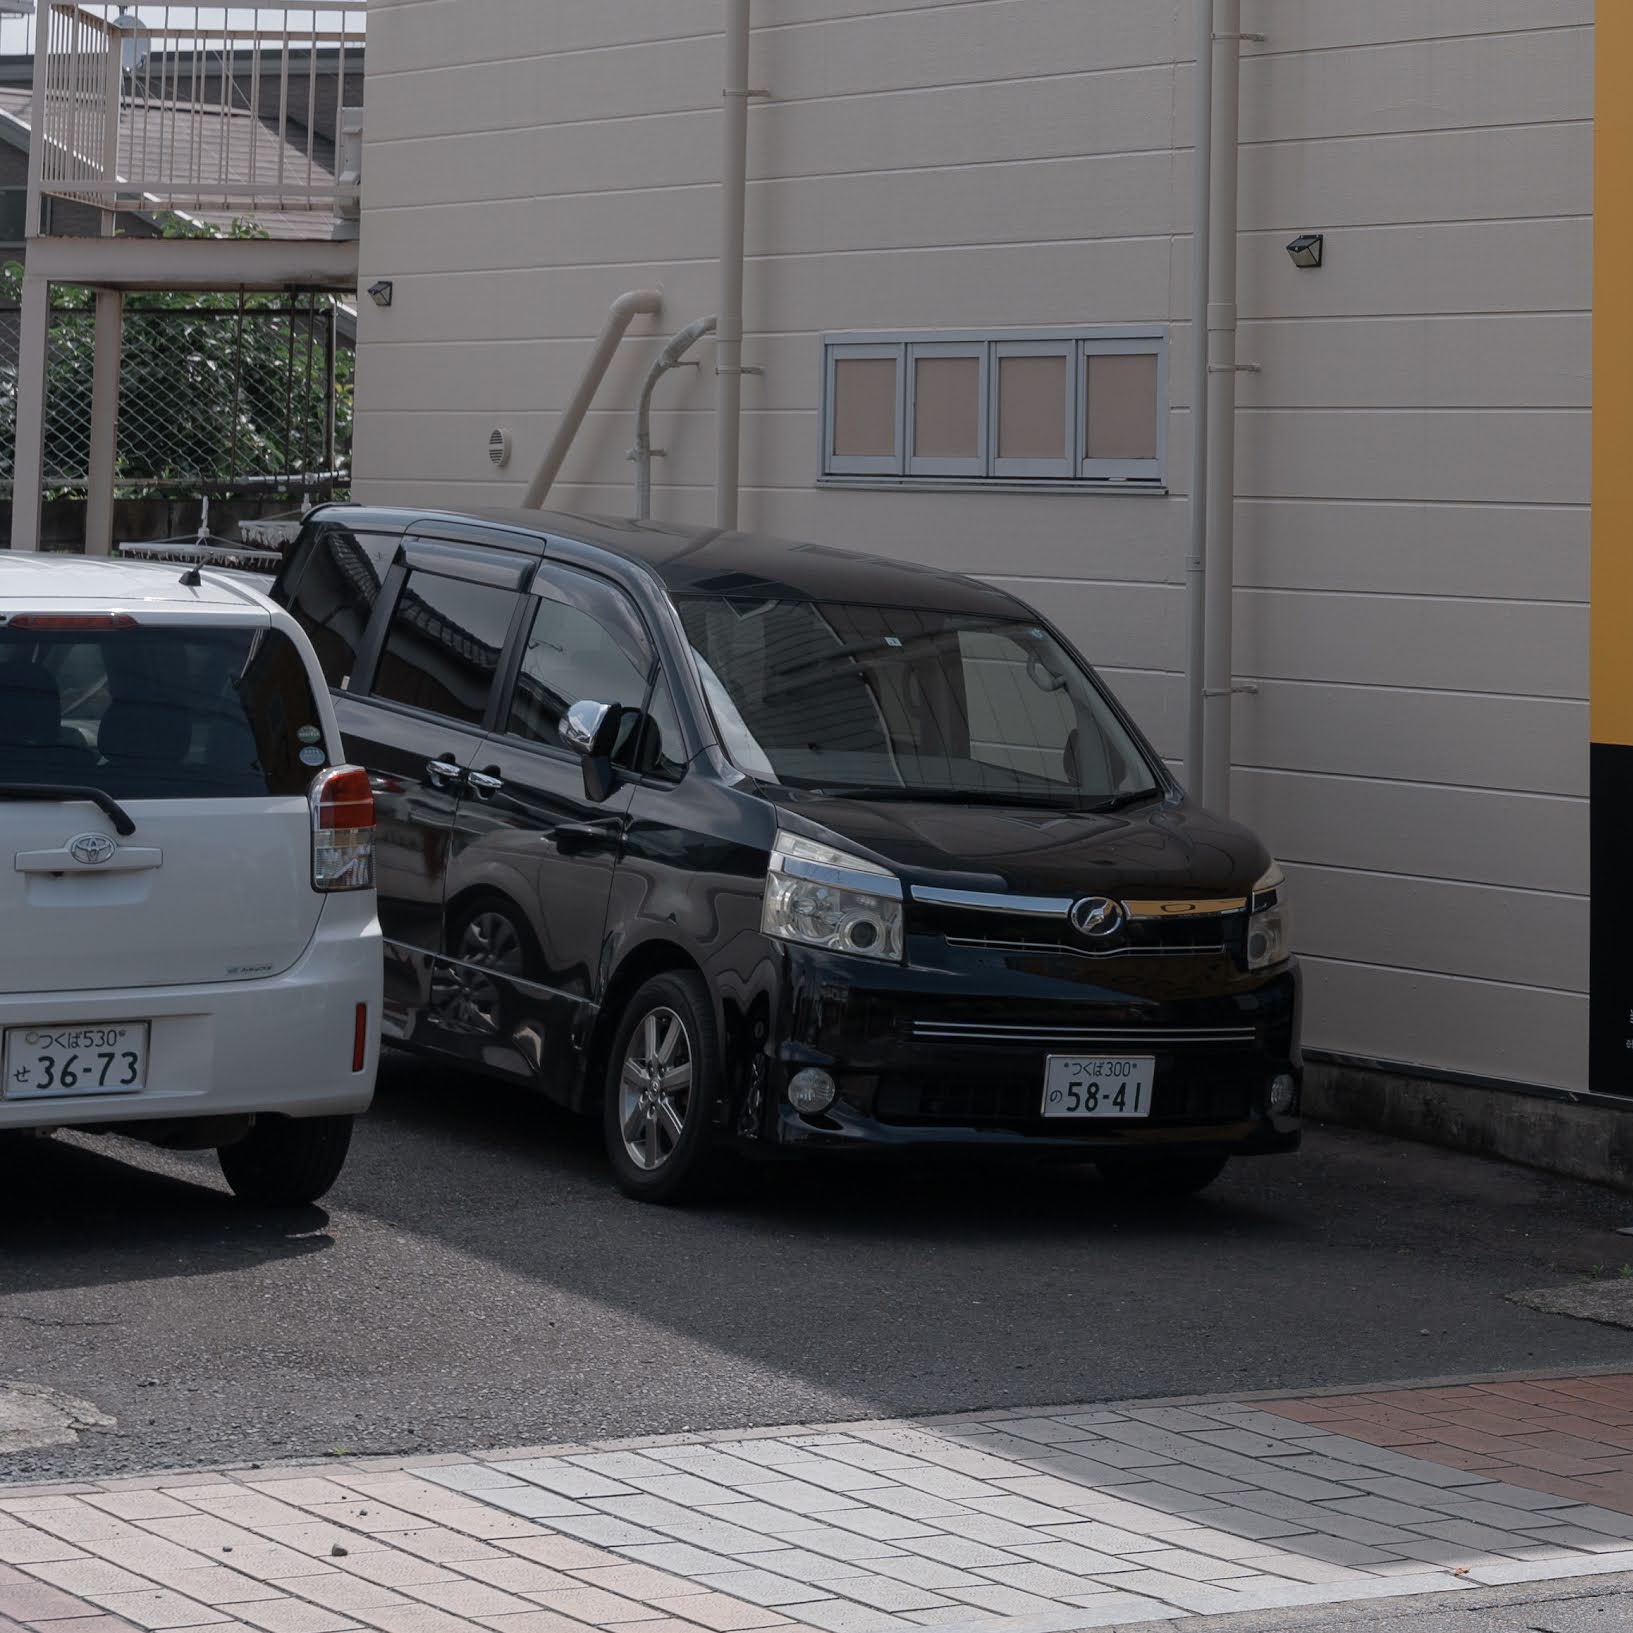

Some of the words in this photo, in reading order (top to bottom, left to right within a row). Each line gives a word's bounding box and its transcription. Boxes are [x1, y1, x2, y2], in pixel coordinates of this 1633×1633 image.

[13, 1066, 31, 1083] せ
[36, 1051, 138, 1089] 36-73
[1050, 1089, 1063, 1103] の
[1066, 1081, 1142, 1112] 58-41
